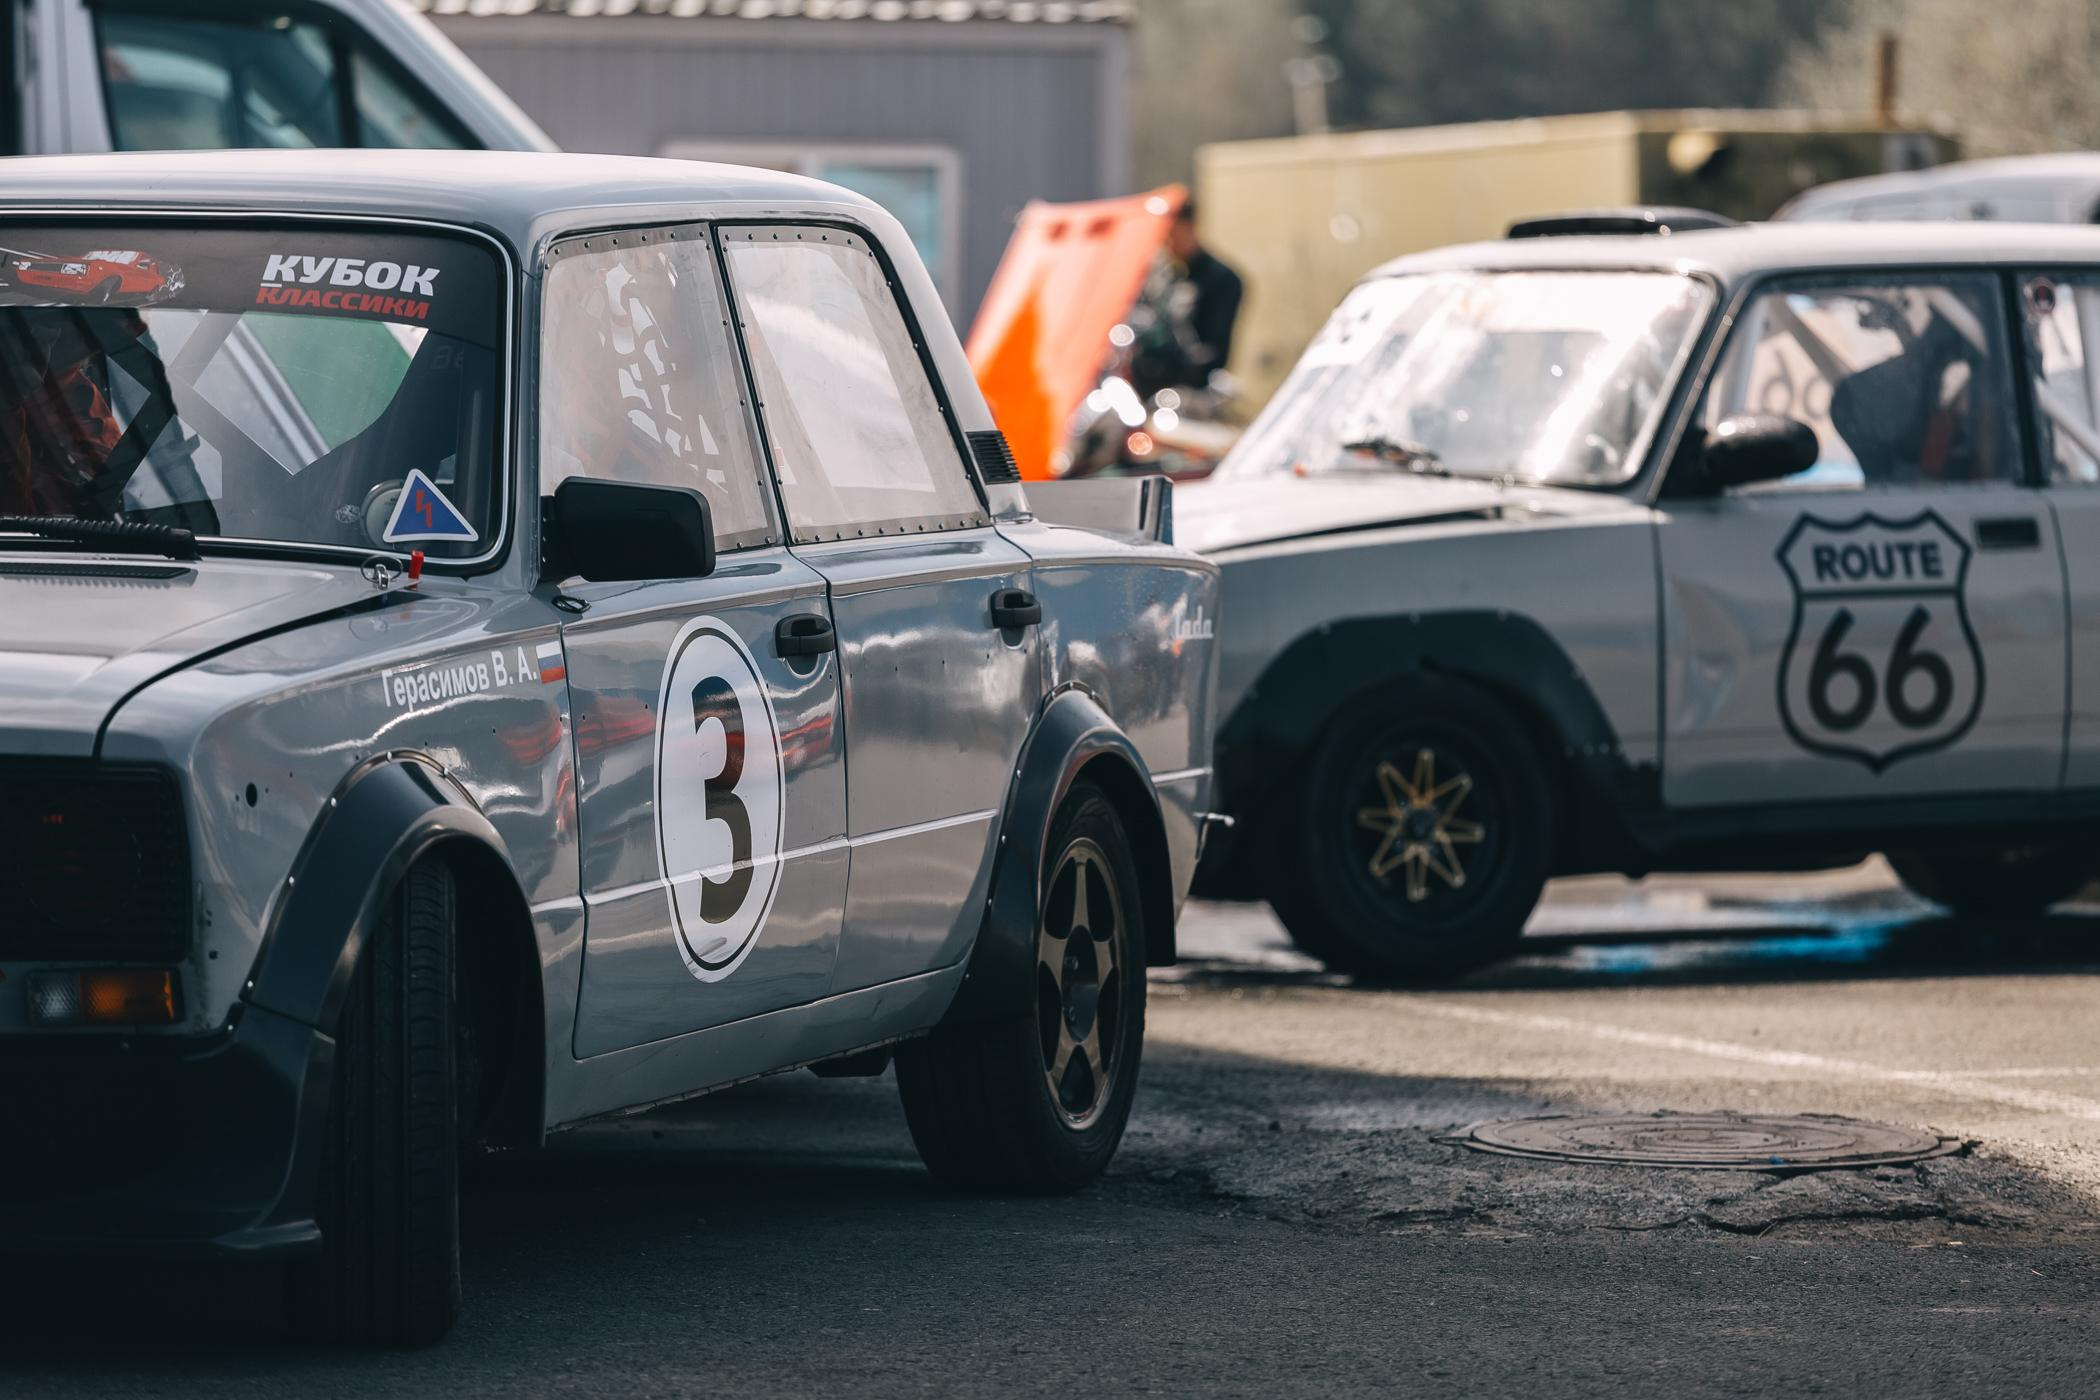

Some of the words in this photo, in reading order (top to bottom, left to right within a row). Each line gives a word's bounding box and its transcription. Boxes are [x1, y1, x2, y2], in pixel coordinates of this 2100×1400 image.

[262, 254, 441, 297] КУБОК
[256, 287, 430, 320] КЛАССИКИ
[1812, 541, 1943, 581] ROUTE
[381, 663, 490, 713] Герасимов
[1807, 604, 1954, 733] 66
[691, 675, 754, 925] 3
